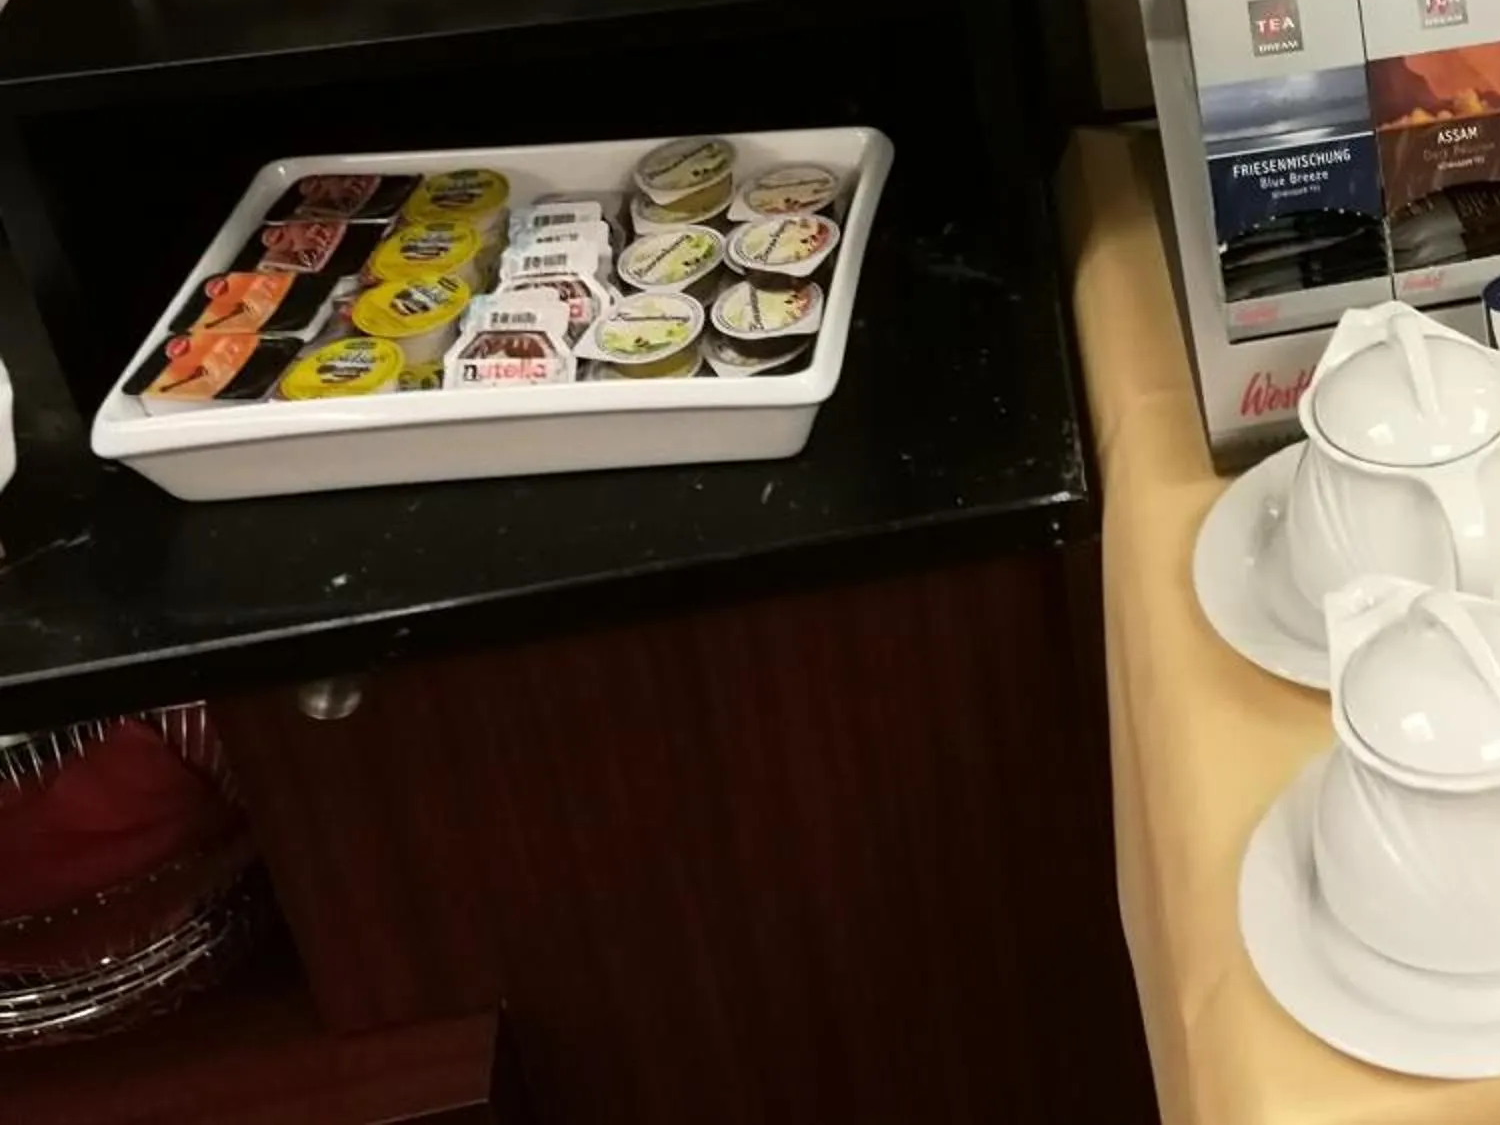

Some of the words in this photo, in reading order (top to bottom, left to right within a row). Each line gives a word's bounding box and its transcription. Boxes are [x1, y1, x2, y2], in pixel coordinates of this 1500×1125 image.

[1256, 16, 1295, 33] TEA
[1437, 126, 1478, 145] ASSAM
[1233, 148, 1351, 179] FRIESENMISCHUNG
[1260, 177, 1286, 190] Blue
[1289, 171, 1329, 185] Breeze
[463, 359, 547, 383] nutella
